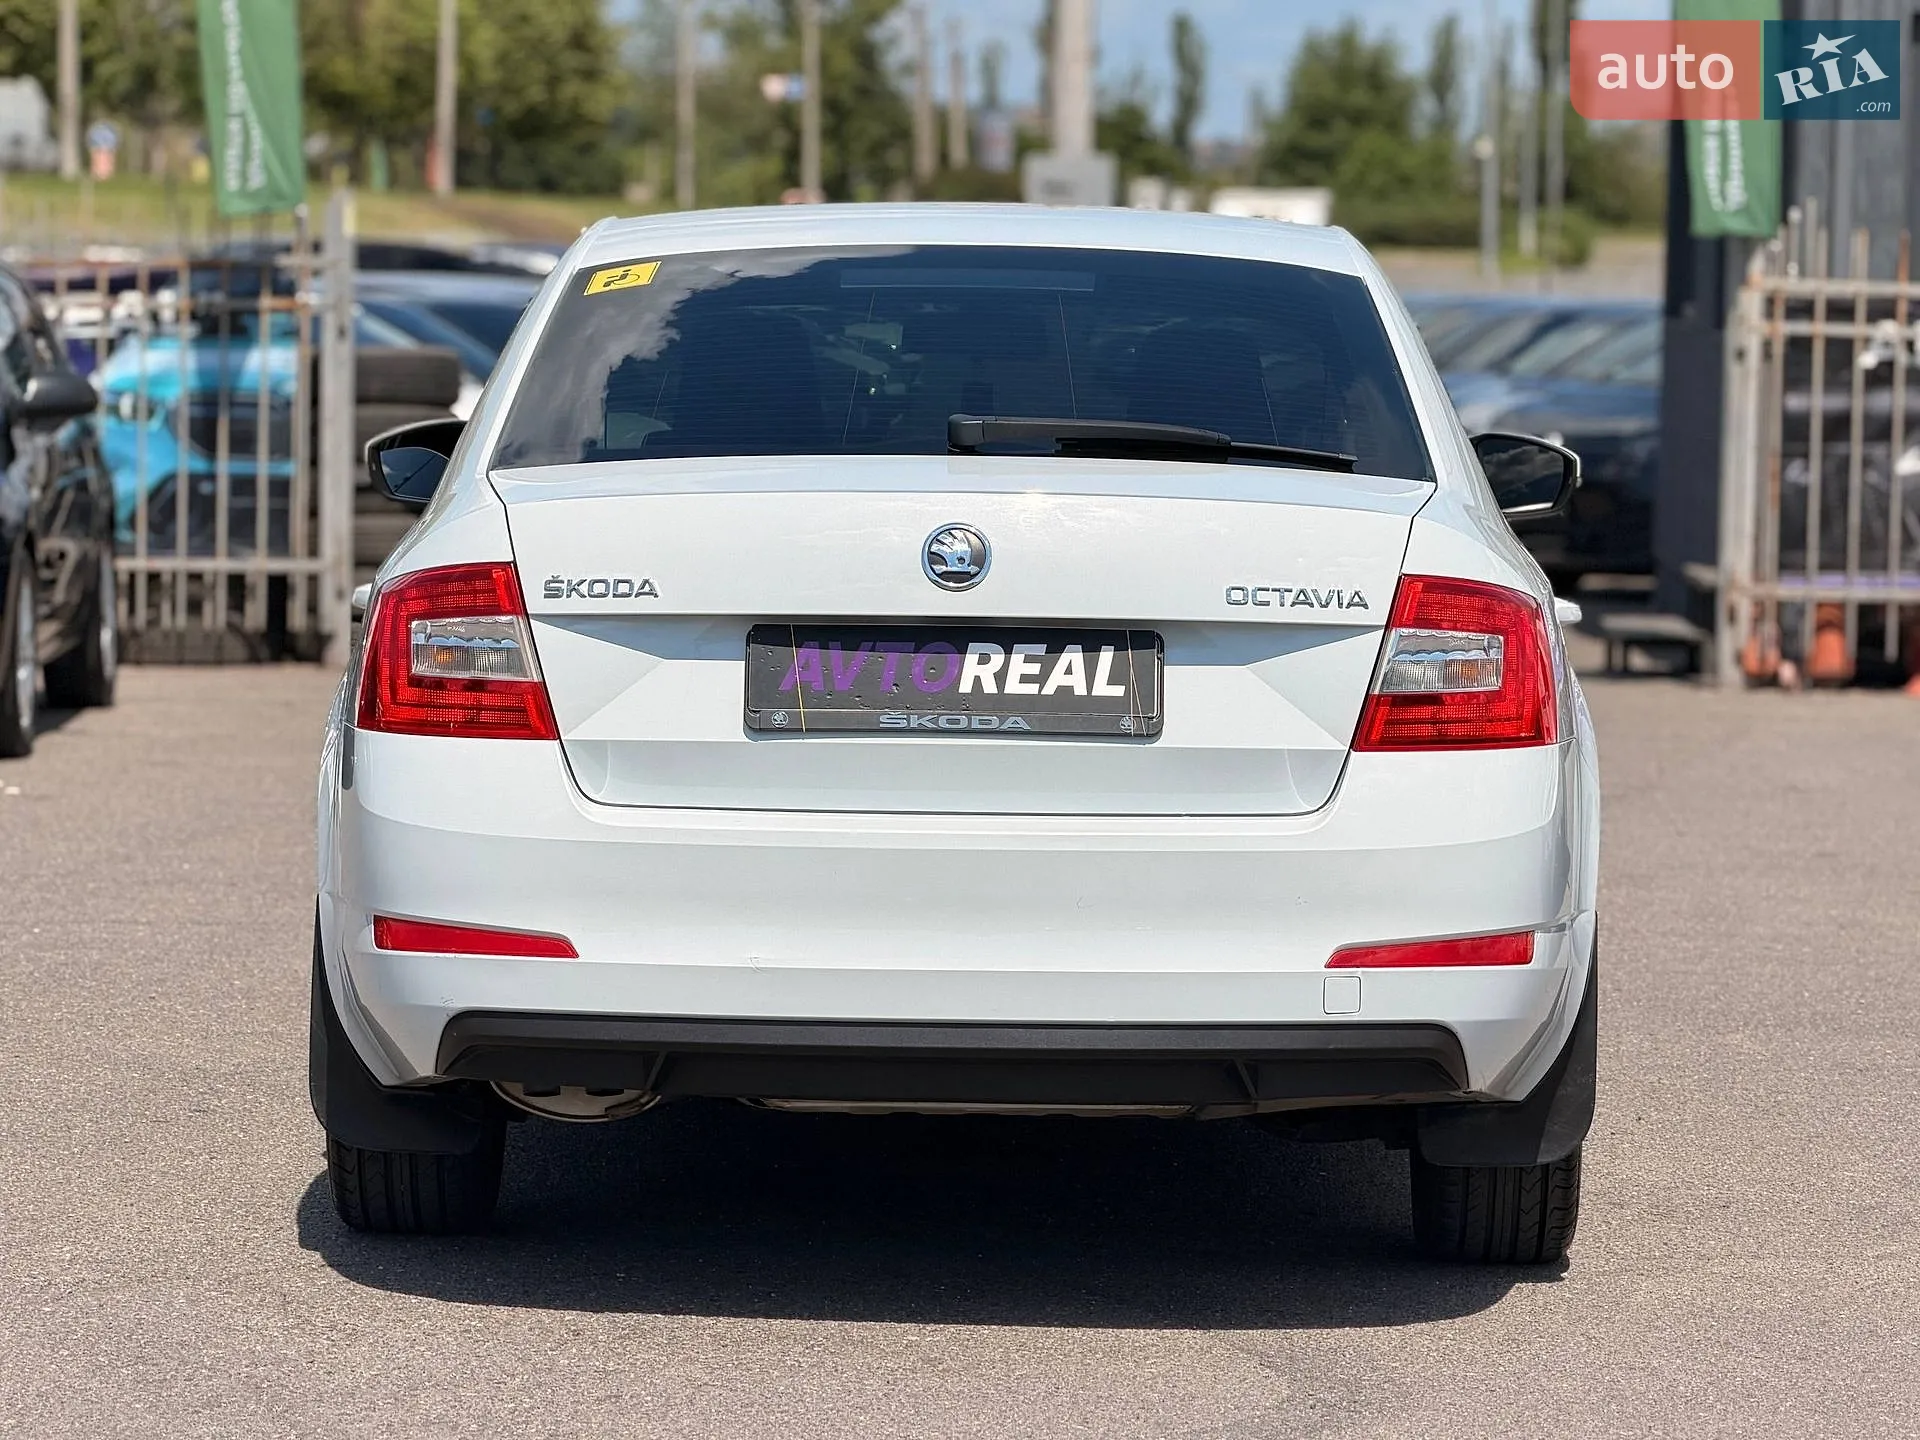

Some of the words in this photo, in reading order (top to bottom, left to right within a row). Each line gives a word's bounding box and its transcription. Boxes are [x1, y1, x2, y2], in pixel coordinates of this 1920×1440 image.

[543, 574, 660, 599] ŠKODA
[1225, 585, 1370, 610] OCTAVIA
[879, 711, 1032, 730] ŠKODA
